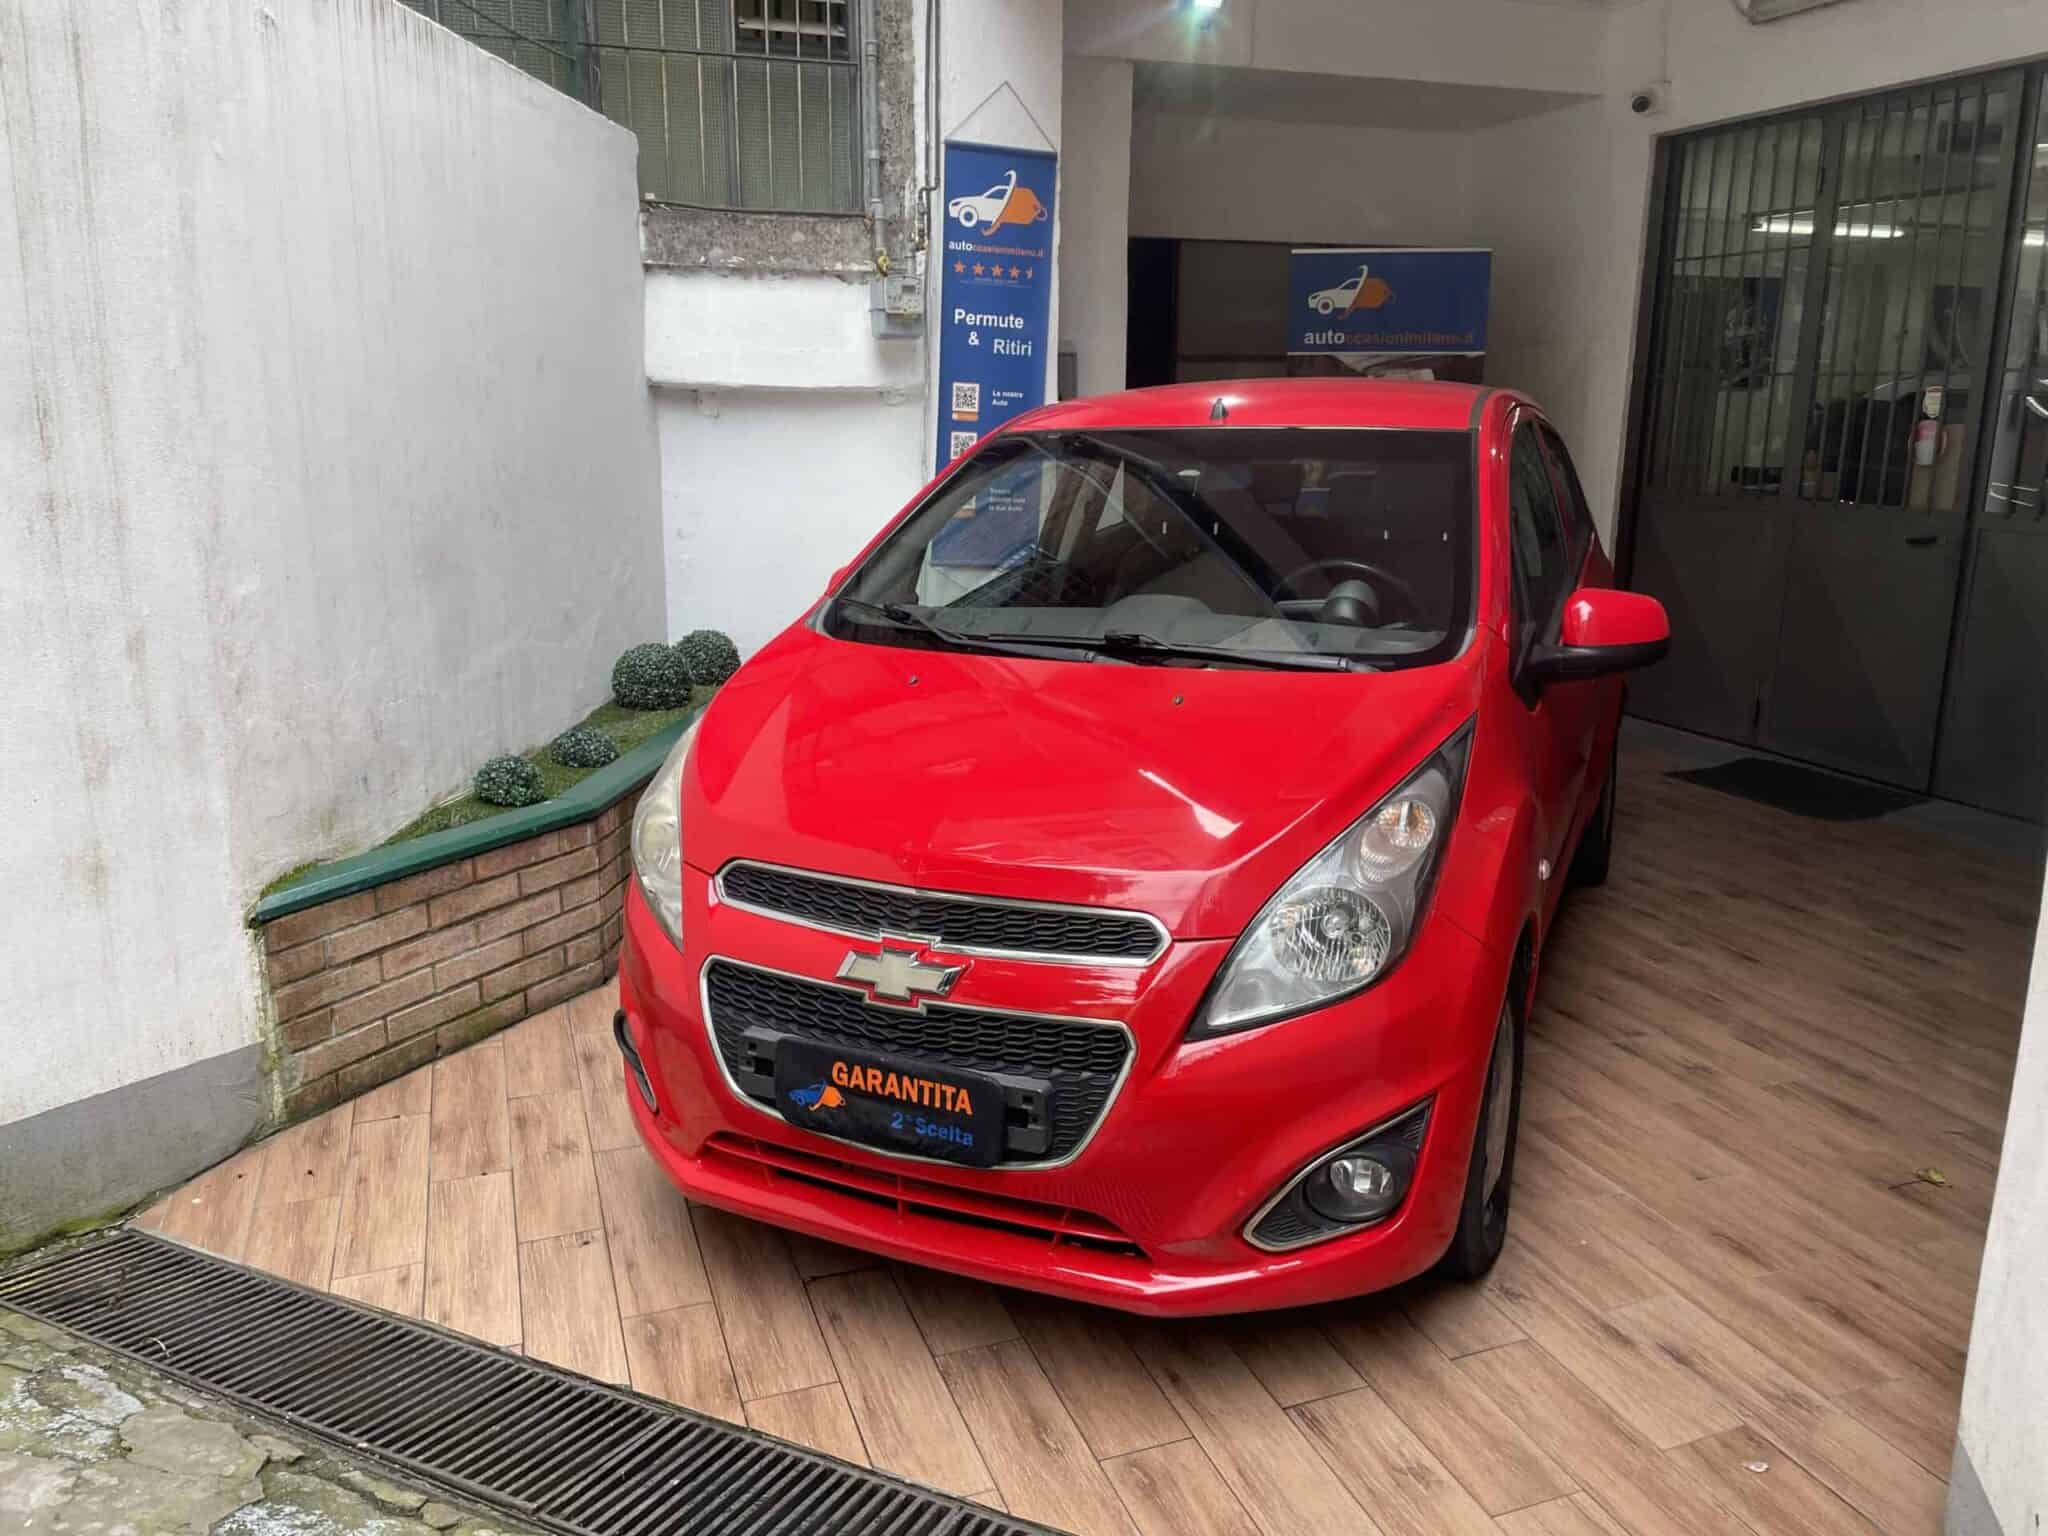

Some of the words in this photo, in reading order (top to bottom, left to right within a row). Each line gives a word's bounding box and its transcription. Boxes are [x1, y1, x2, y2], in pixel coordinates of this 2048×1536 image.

[954, 308, 1024, 328] Permute
[968, 331, 979, 345] &
[993, 338, 1032, 357] Ritiri
[832, 1061, 973, 1115] GARANTITA
[914, 1116, 974, 1146] Scelta
